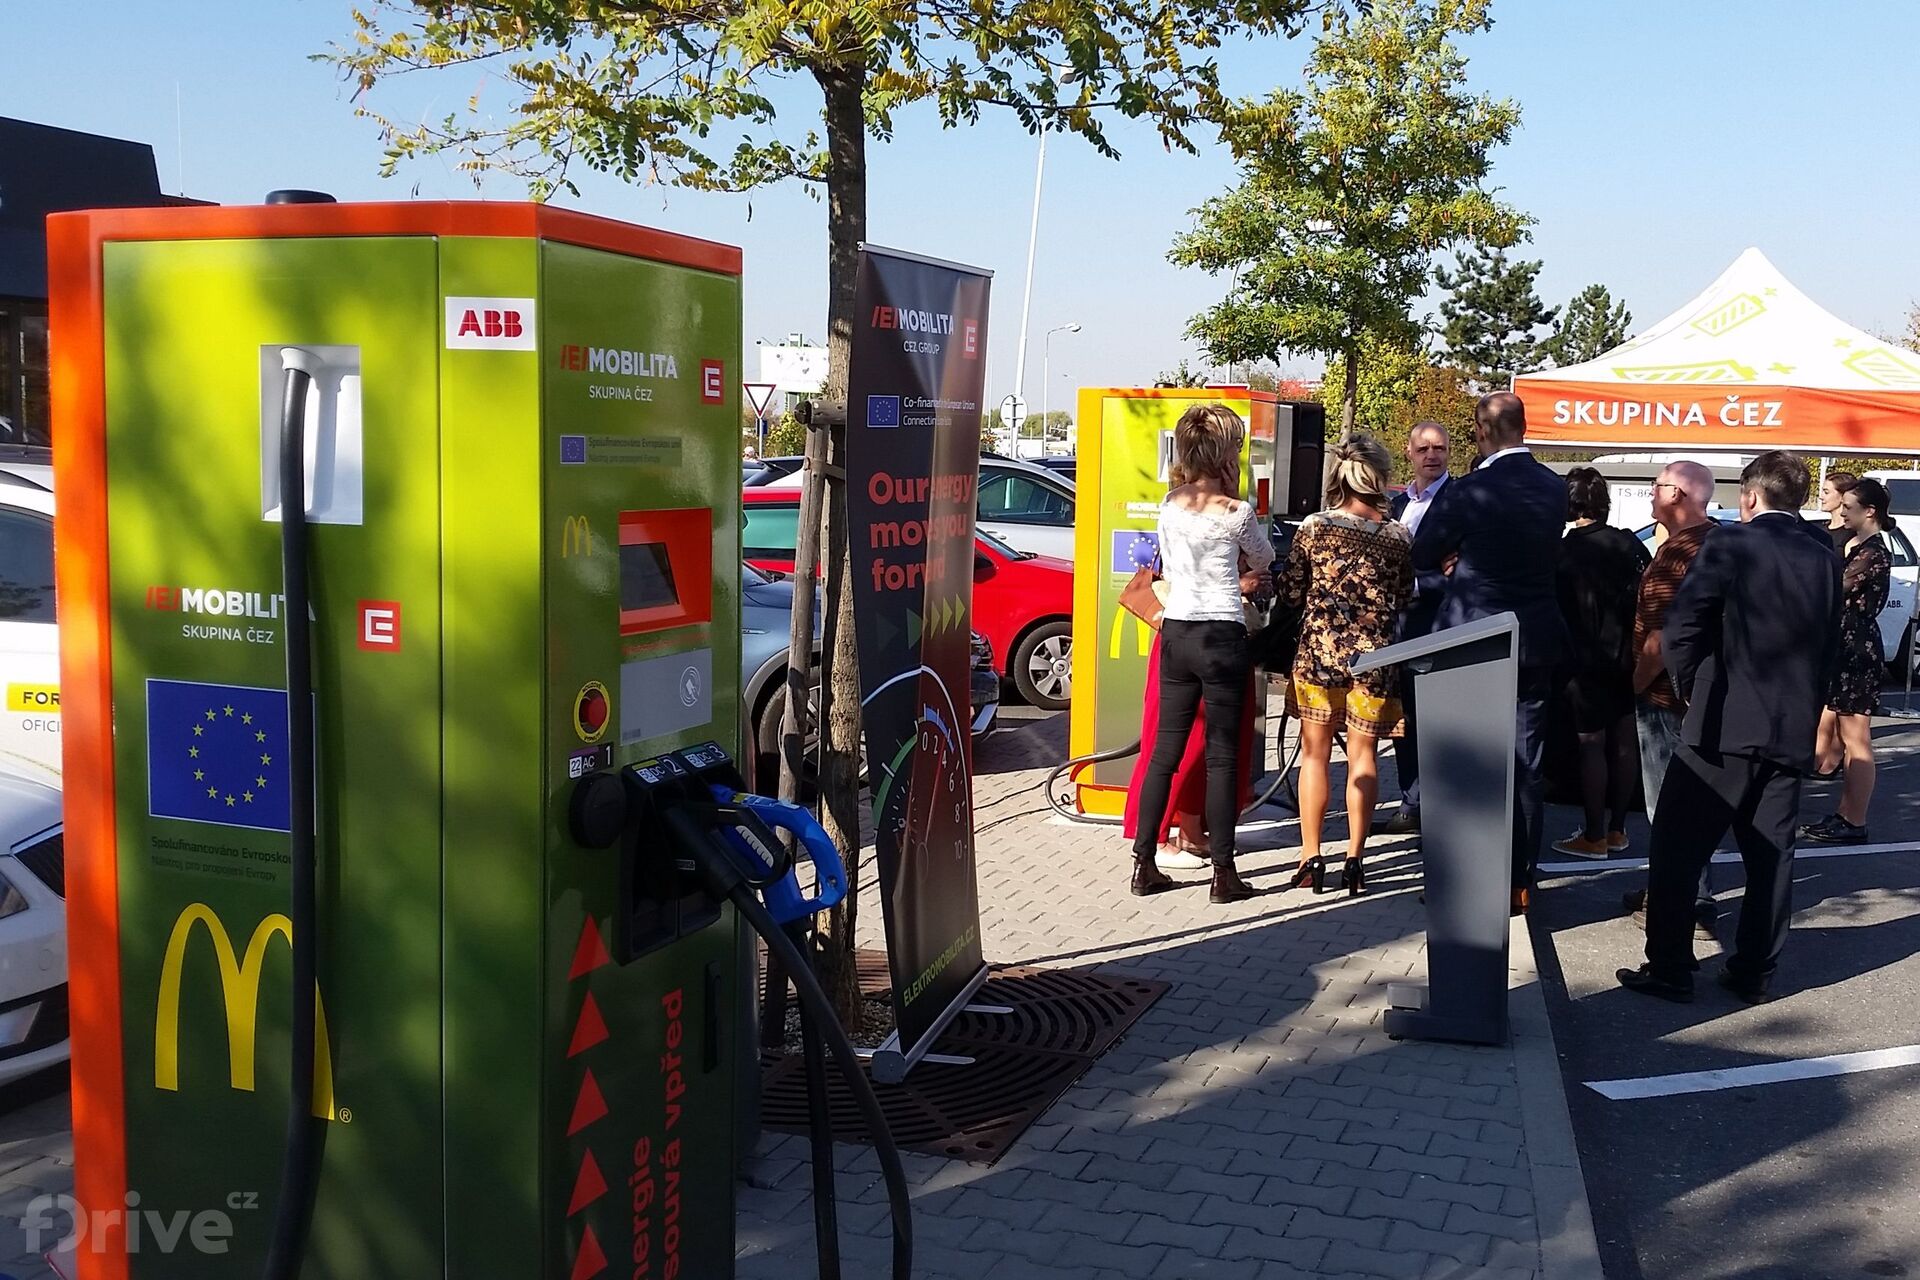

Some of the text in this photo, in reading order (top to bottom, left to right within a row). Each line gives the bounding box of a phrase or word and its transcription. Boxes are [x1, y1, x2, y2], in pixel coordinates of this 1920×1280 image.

[458, 309, 523, 338] ABB
[918, 342, 940, 355] GROUP
[589, 384, 653, 401] SKUPINA ČEZ
[1553, 394, 1783, 427] SKUPINA ČEZ
[868, 471, 928, 505] Our
[182, 624, 274, 645] SKUPINA ČEZ
[571, 759, 581, 772] 22
[582, 755, 595, 769] AC
[605, 745, 611, 766] 1
[709, 745, 725, 759] 3
[663, 758, 682, 774] 2
[922, 731, 928, 751] 0
[933, 735, 939, 755] 2
[941, 749, 947, 769] 4
[949, 772, 955, 792] 6
[954, 803, 960, 823] 8
[659, 987, 686, 1131] vpřed
